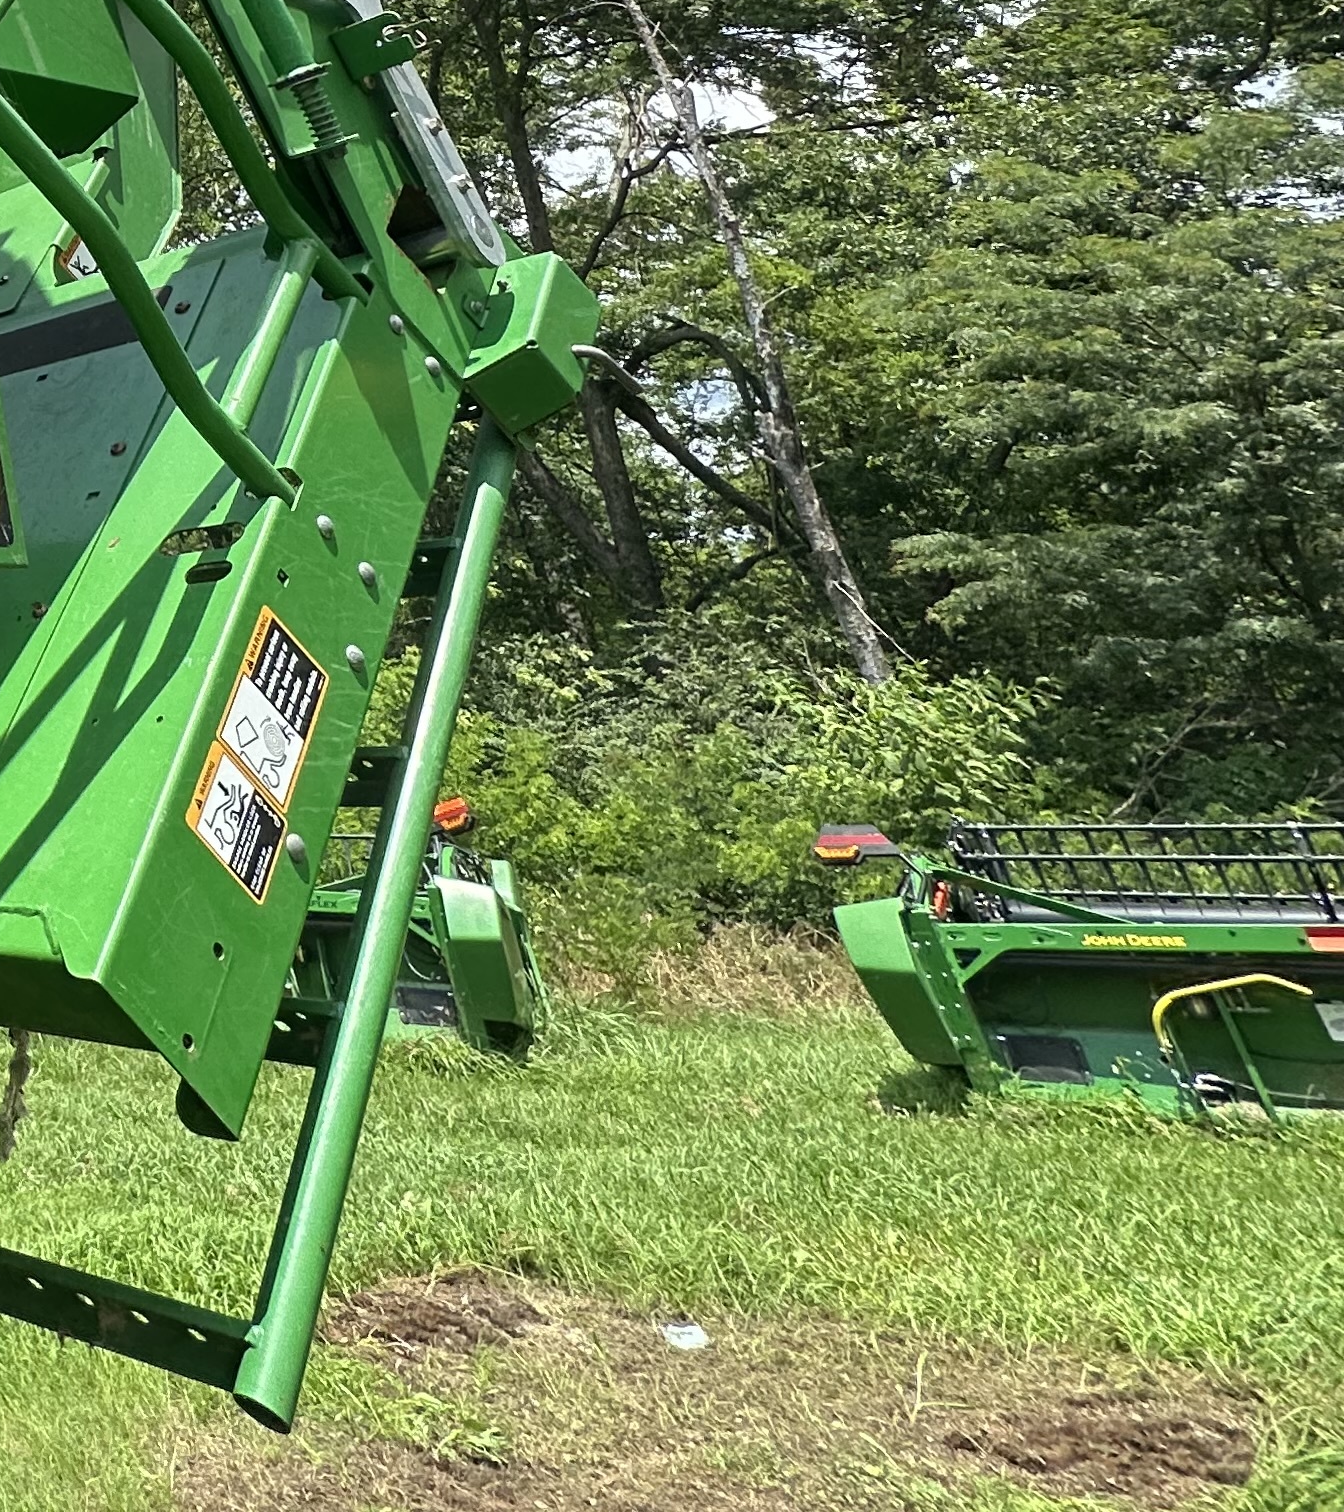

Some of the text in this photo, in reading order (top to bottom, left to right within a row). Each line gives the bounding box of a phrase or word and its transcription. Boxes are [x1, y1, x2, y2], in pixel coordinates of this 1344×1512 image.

[248, 615, 269, 660] WARNING
[310, 899, 338, 909] FLEX
[1081, 933, 1187, 947] JOHN DEERE
